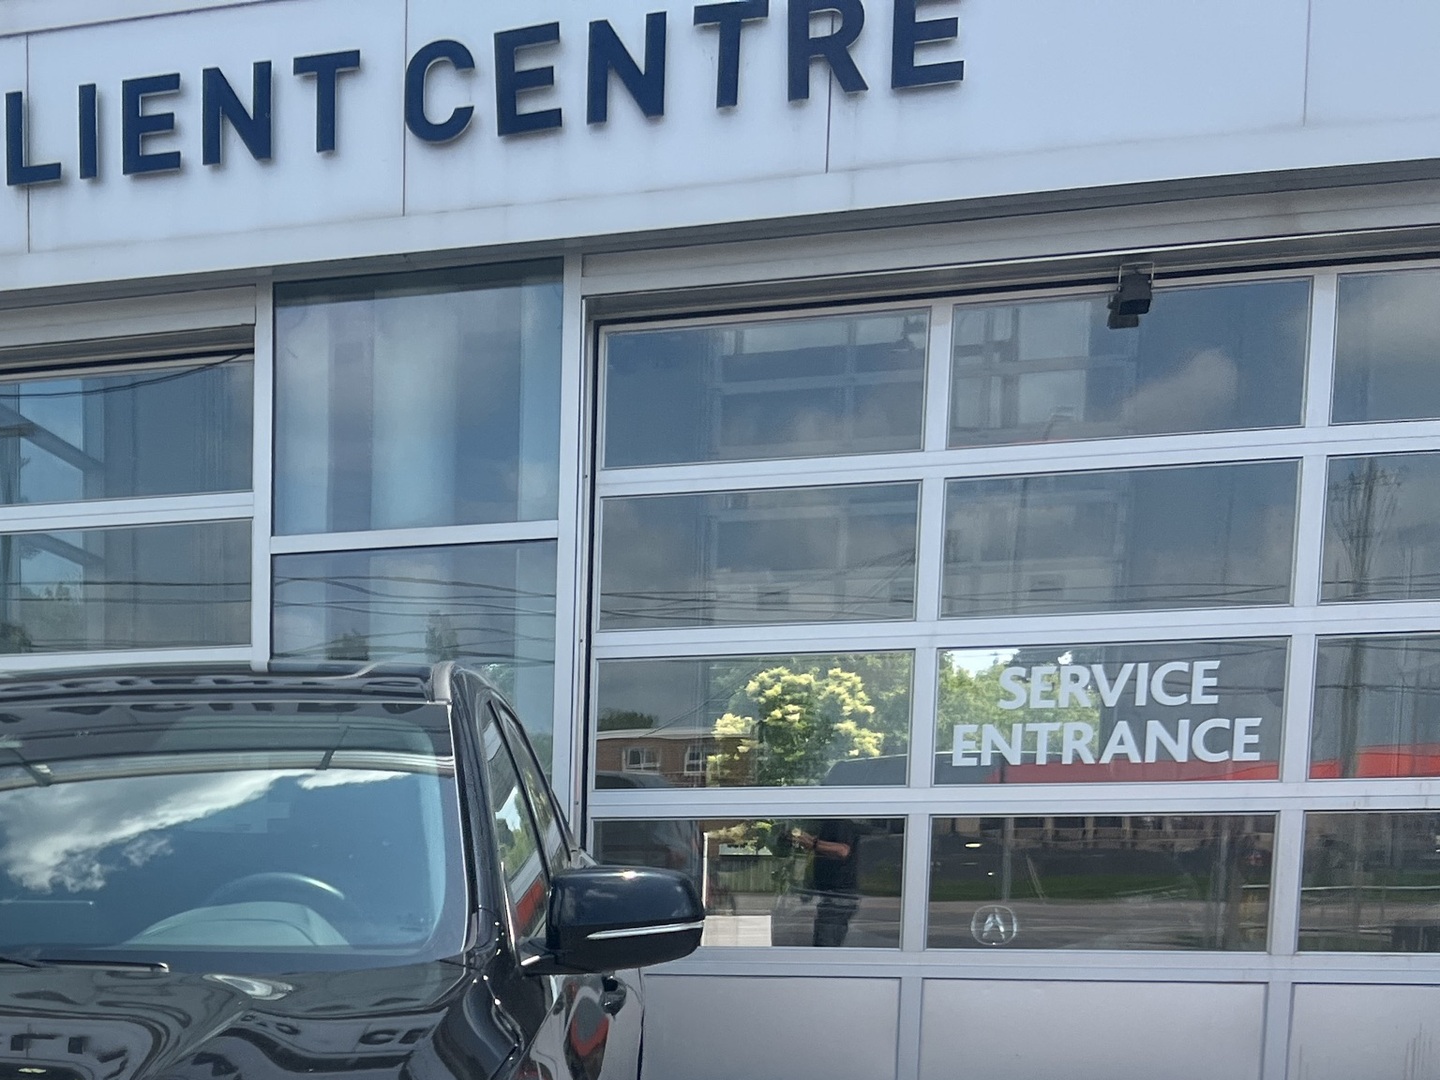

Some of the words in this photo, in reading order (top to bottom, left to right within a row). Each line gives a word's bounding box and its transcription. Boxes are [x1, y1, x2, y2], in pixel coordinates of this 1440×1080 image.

[404, 0, 964, 143] CENTRE
[998, 660, 1221, 710] SERVICE
[952, 717, 1262, 767] ENTRANCE
